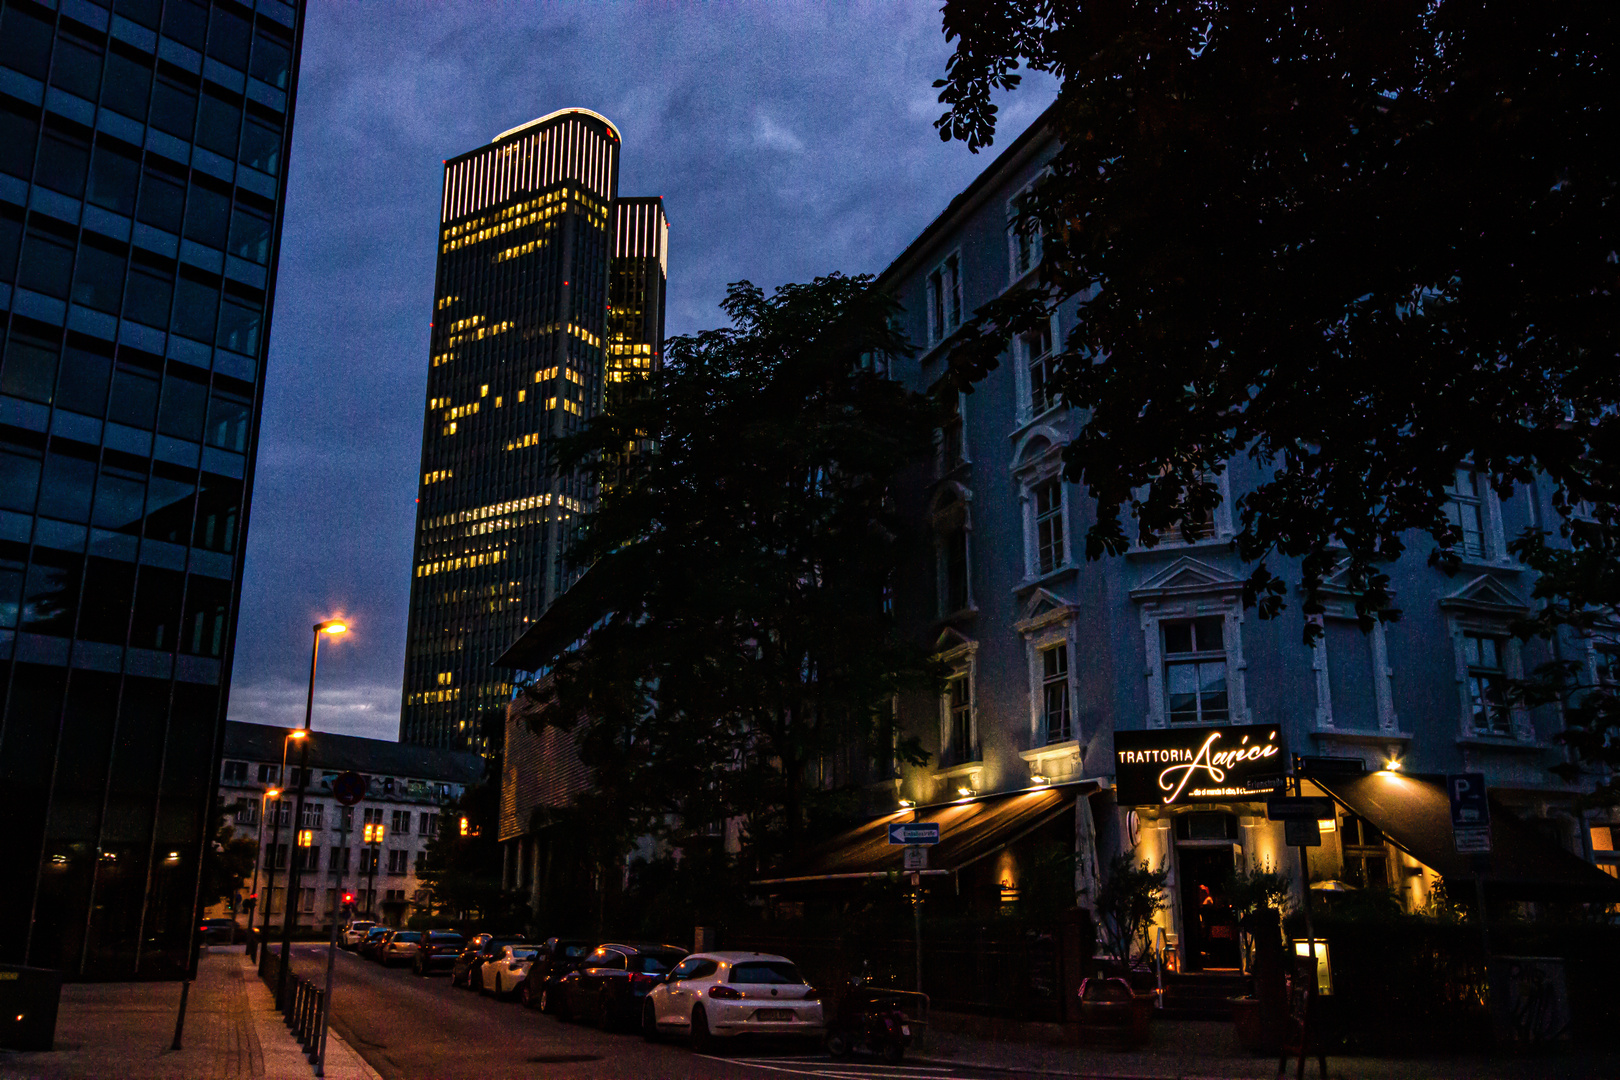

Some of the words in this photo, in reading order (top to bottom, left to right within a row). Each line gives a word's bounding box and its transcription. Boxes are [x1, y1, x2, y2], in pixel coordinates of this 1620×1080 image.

[1118, 749, 1193, 764] TRATTORIA
[1158, 730, 1279, 804] Amici
[1453, 778, 1470, 802] P
